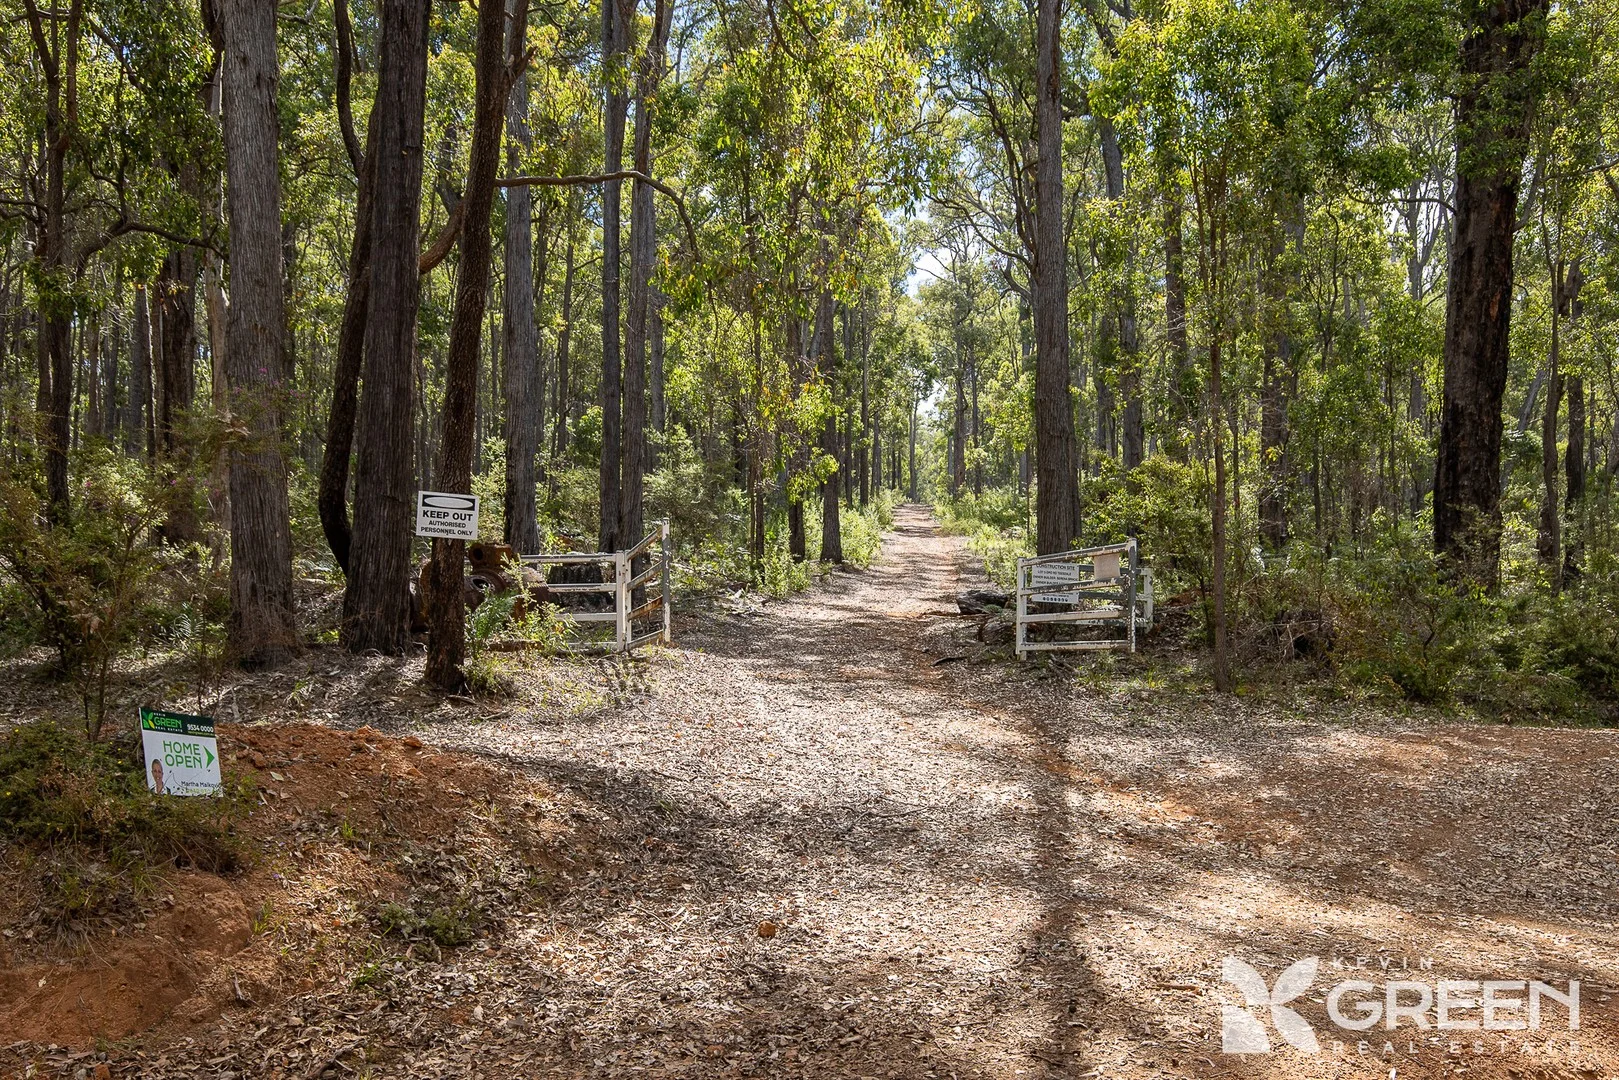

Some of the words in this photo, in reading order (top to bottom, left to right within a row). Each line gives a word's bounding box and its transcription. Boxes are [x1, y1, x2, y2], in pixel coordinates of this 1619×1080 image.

[422, 509, 450, 519] KEEP
[452, 512, 473, 521] OUT
[428, 520, 467, 528] AUTHORISED
[420, 526, 456, 535] PERSONNEL
[153, 716, 183, 729] GREEN
[200, 725, 214, 733] 0000
[163, 740, 201, 755] HOME
[164, 754, 203, 769] OPEN
